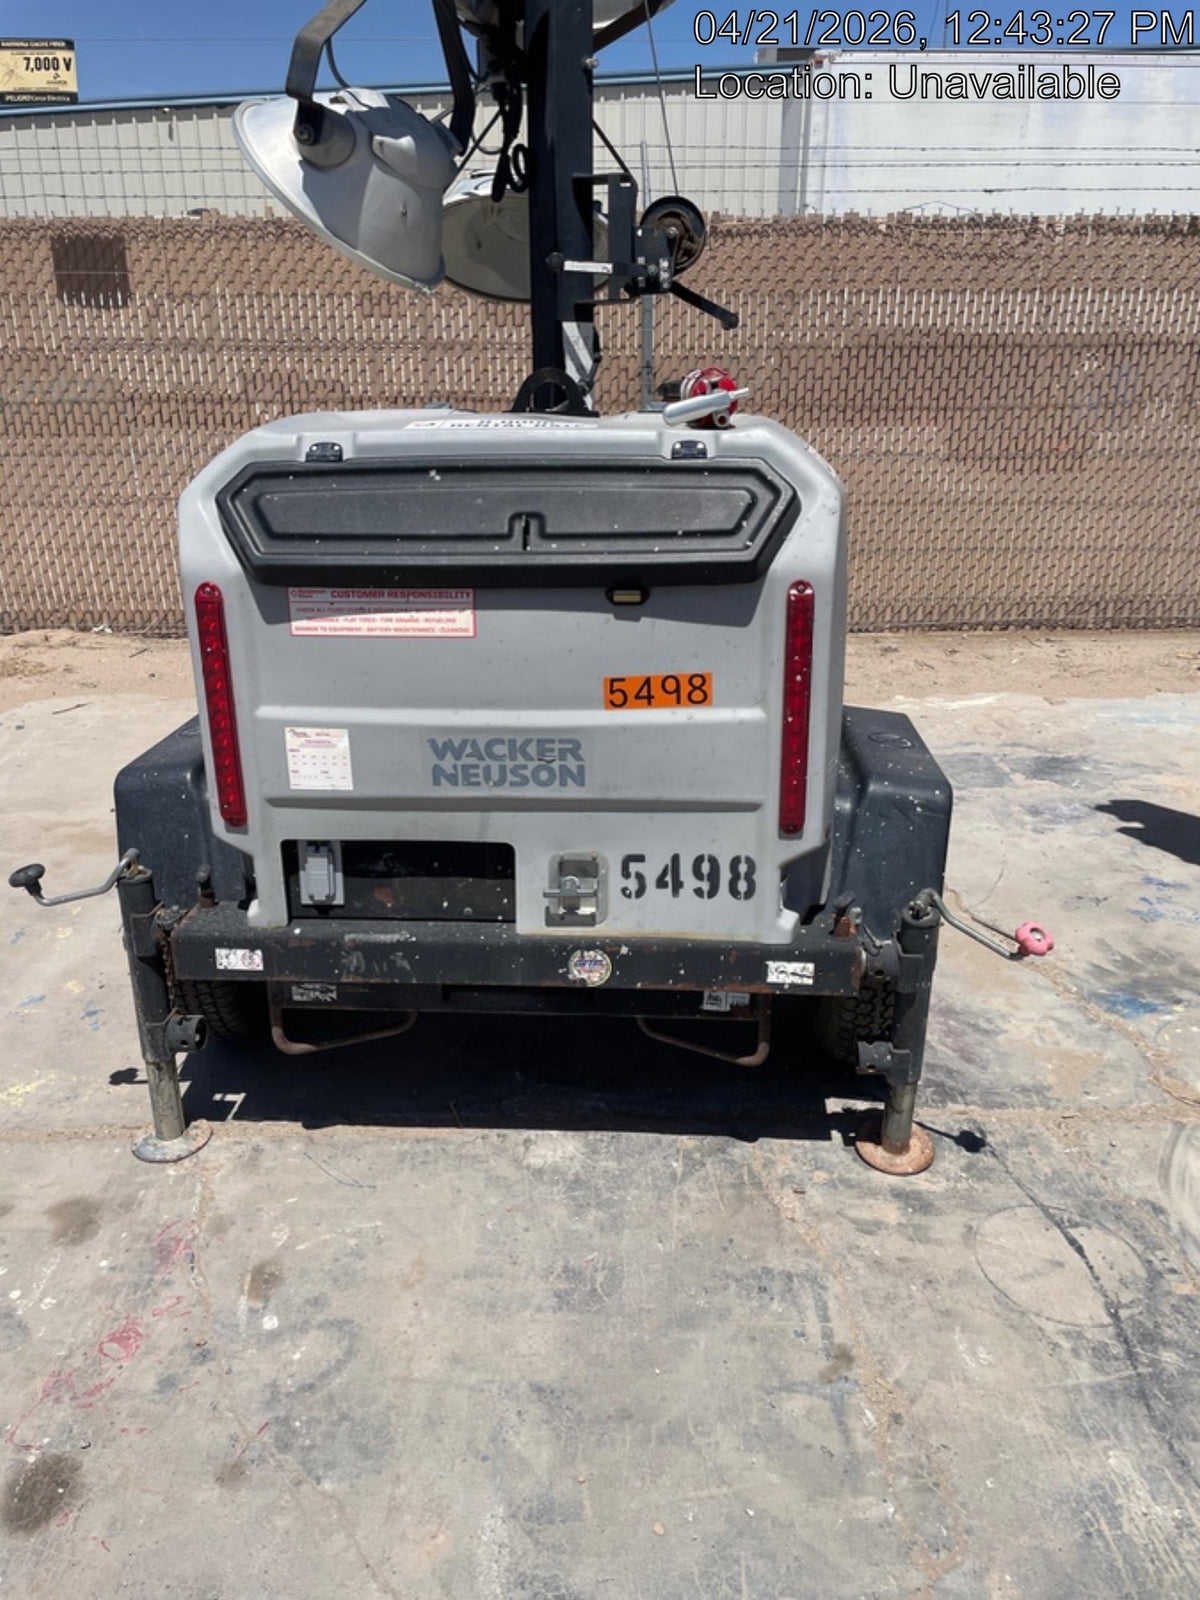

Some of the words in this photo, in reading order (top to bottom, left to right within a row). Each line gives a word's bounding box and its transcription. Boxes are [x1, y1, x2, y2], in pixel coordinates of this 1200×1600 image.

[23, 56, 60, 73] 7,000
[63, 56, 72, 72] V
[330, 589, 385, 599] CUSTOMER
[387, 589, 471, 600] RESPONSIBILITY
[608, 673, 709, 708] 5498
[426, 737, 586, 762] WACKER
[432, 763, 586, 787] NEUSON
[620, 853, 757, 900] 5498
